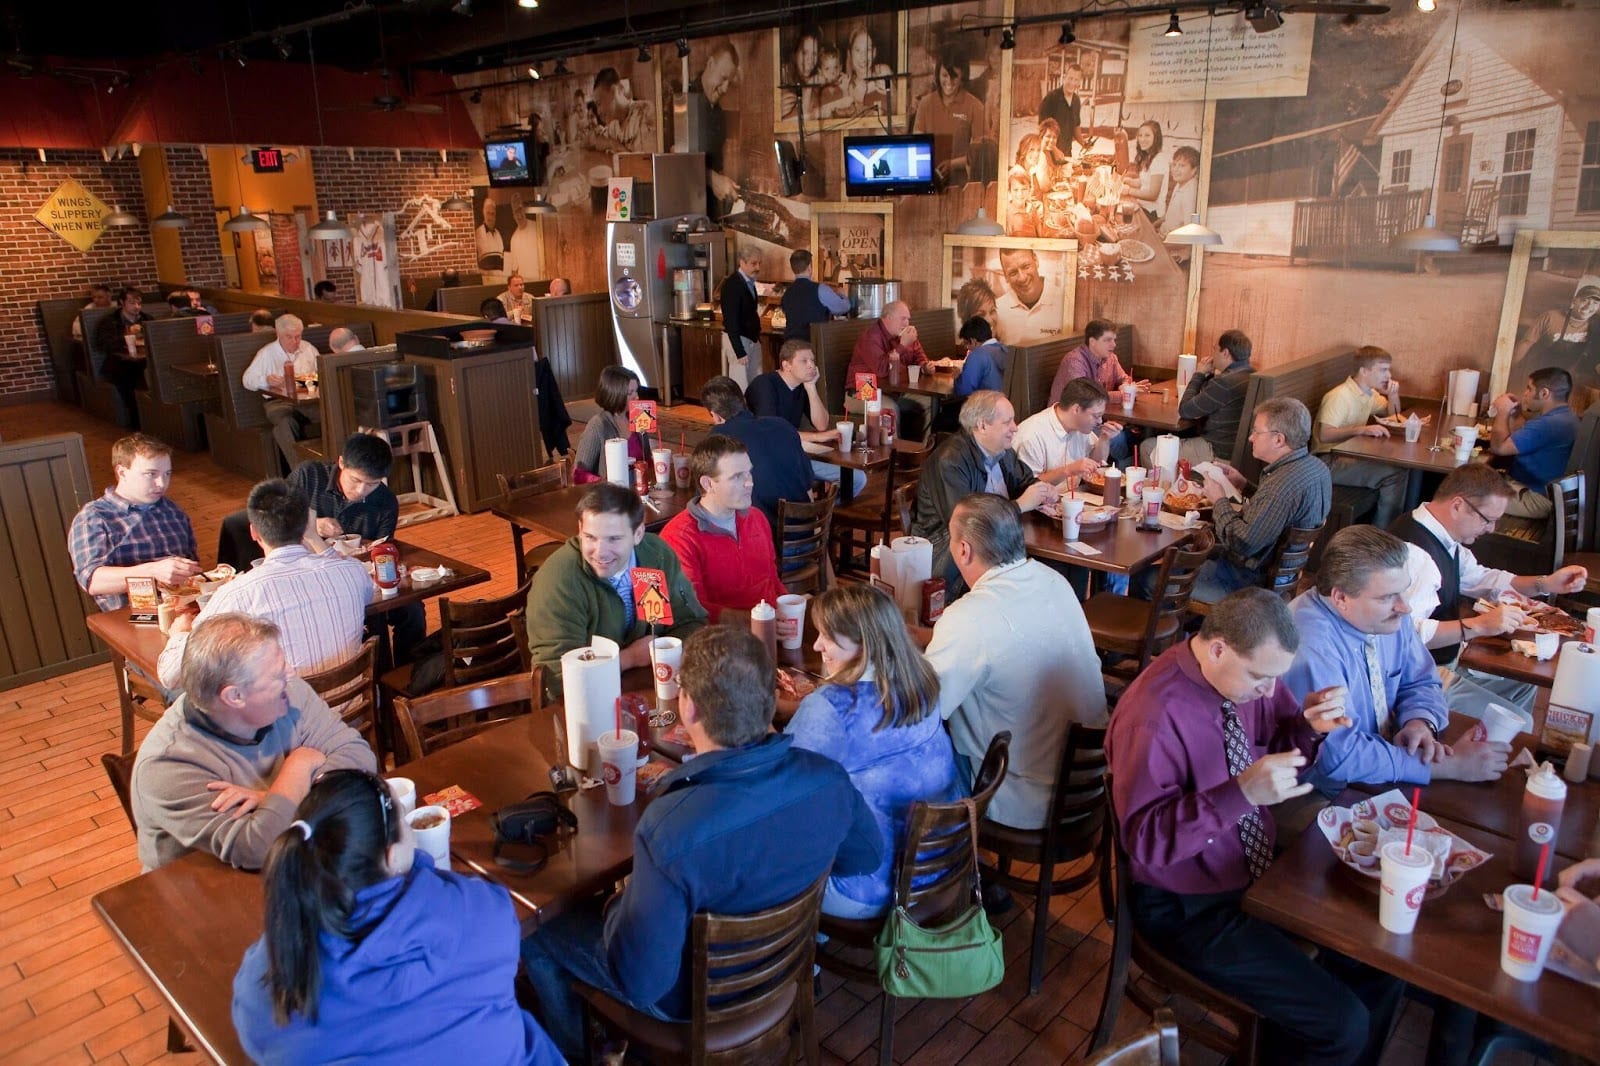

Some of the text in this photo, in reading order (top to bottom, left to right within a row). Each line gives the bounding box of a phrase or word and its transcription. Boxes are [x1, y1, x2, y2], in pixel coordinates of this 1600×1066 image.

[258, 151, 278, 166] EXIT
[57, 198, 92, 207] WINGS
[50, 209, 102, 219] SLIPPERY
[52, 221, 83, 231] WHEN
[849, 229, 871, 239] NOW
[842, 237, 881, 249] OPEN
